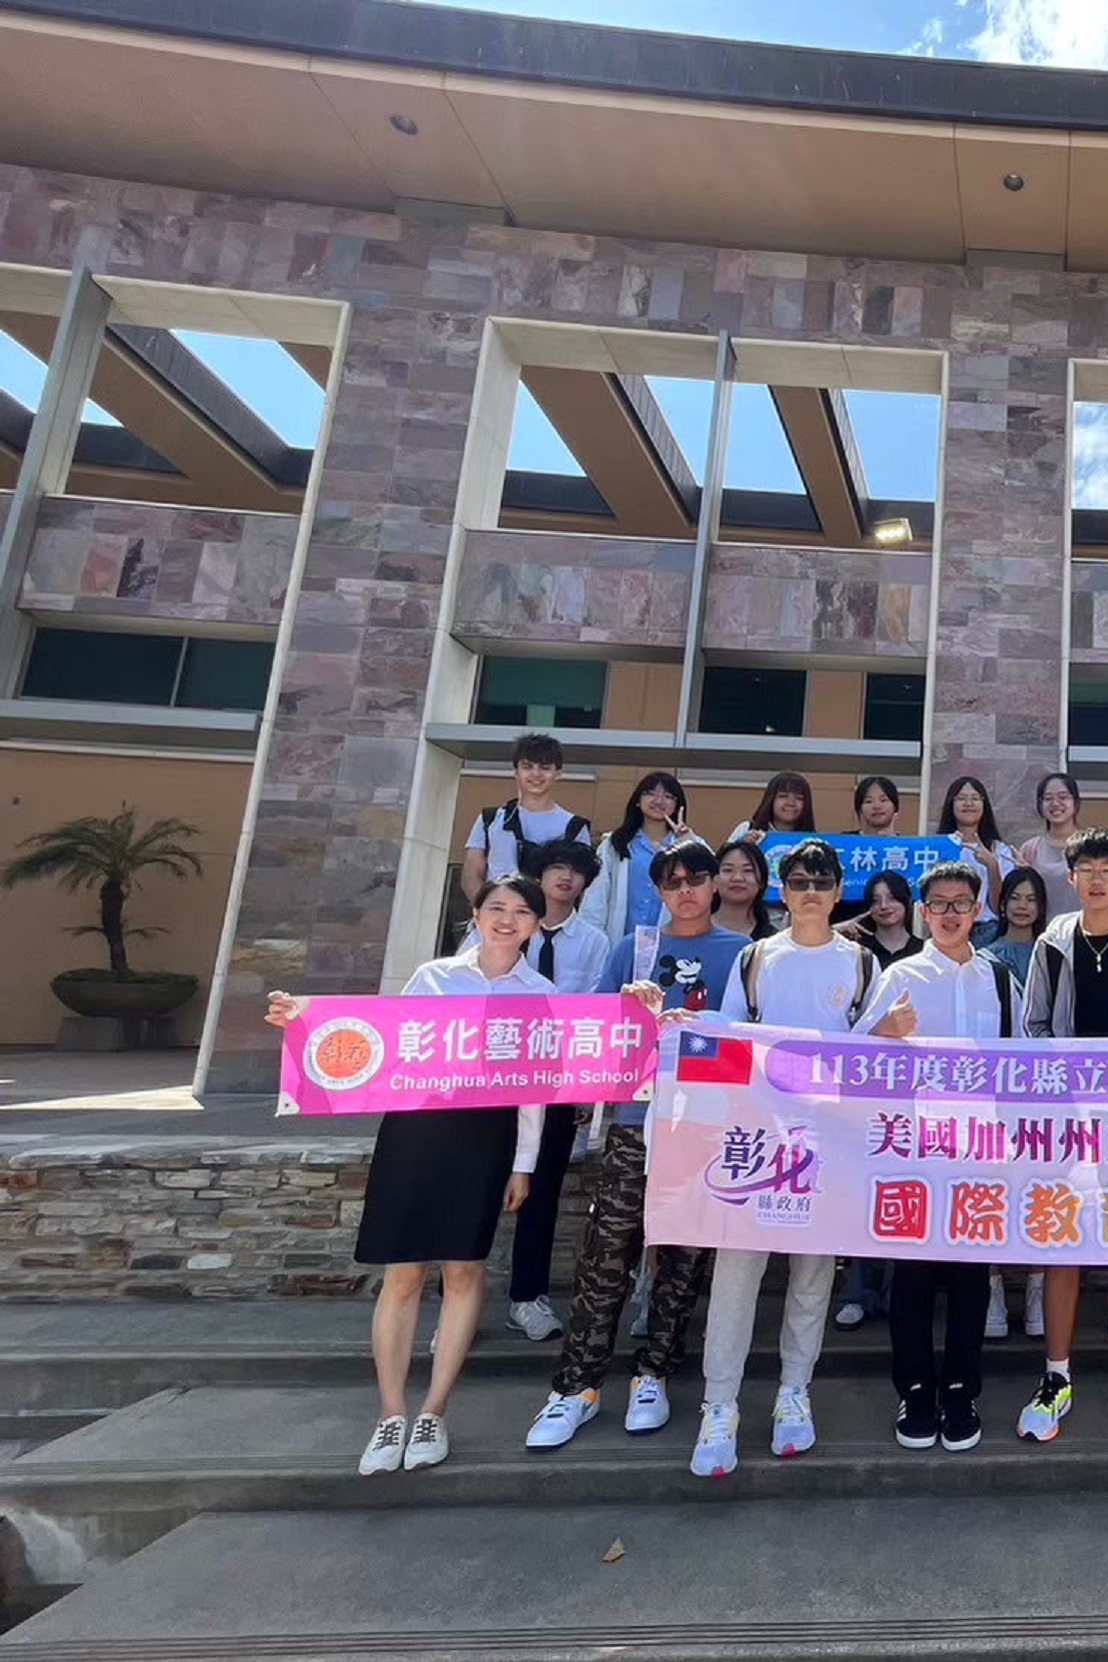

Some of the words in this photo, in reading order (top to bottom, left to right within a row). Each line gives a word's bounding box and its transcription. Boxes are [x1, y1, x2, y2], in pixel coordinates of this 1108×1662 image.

[398, 1016, 642, 1063] 彰化藝術高中
[389, 1073, 486, 1092] Changhua
[491, 1072, 529, 1087] Arts
[533, 1070, 574, 1088] High
[579, 1068, 639, 1084] School
